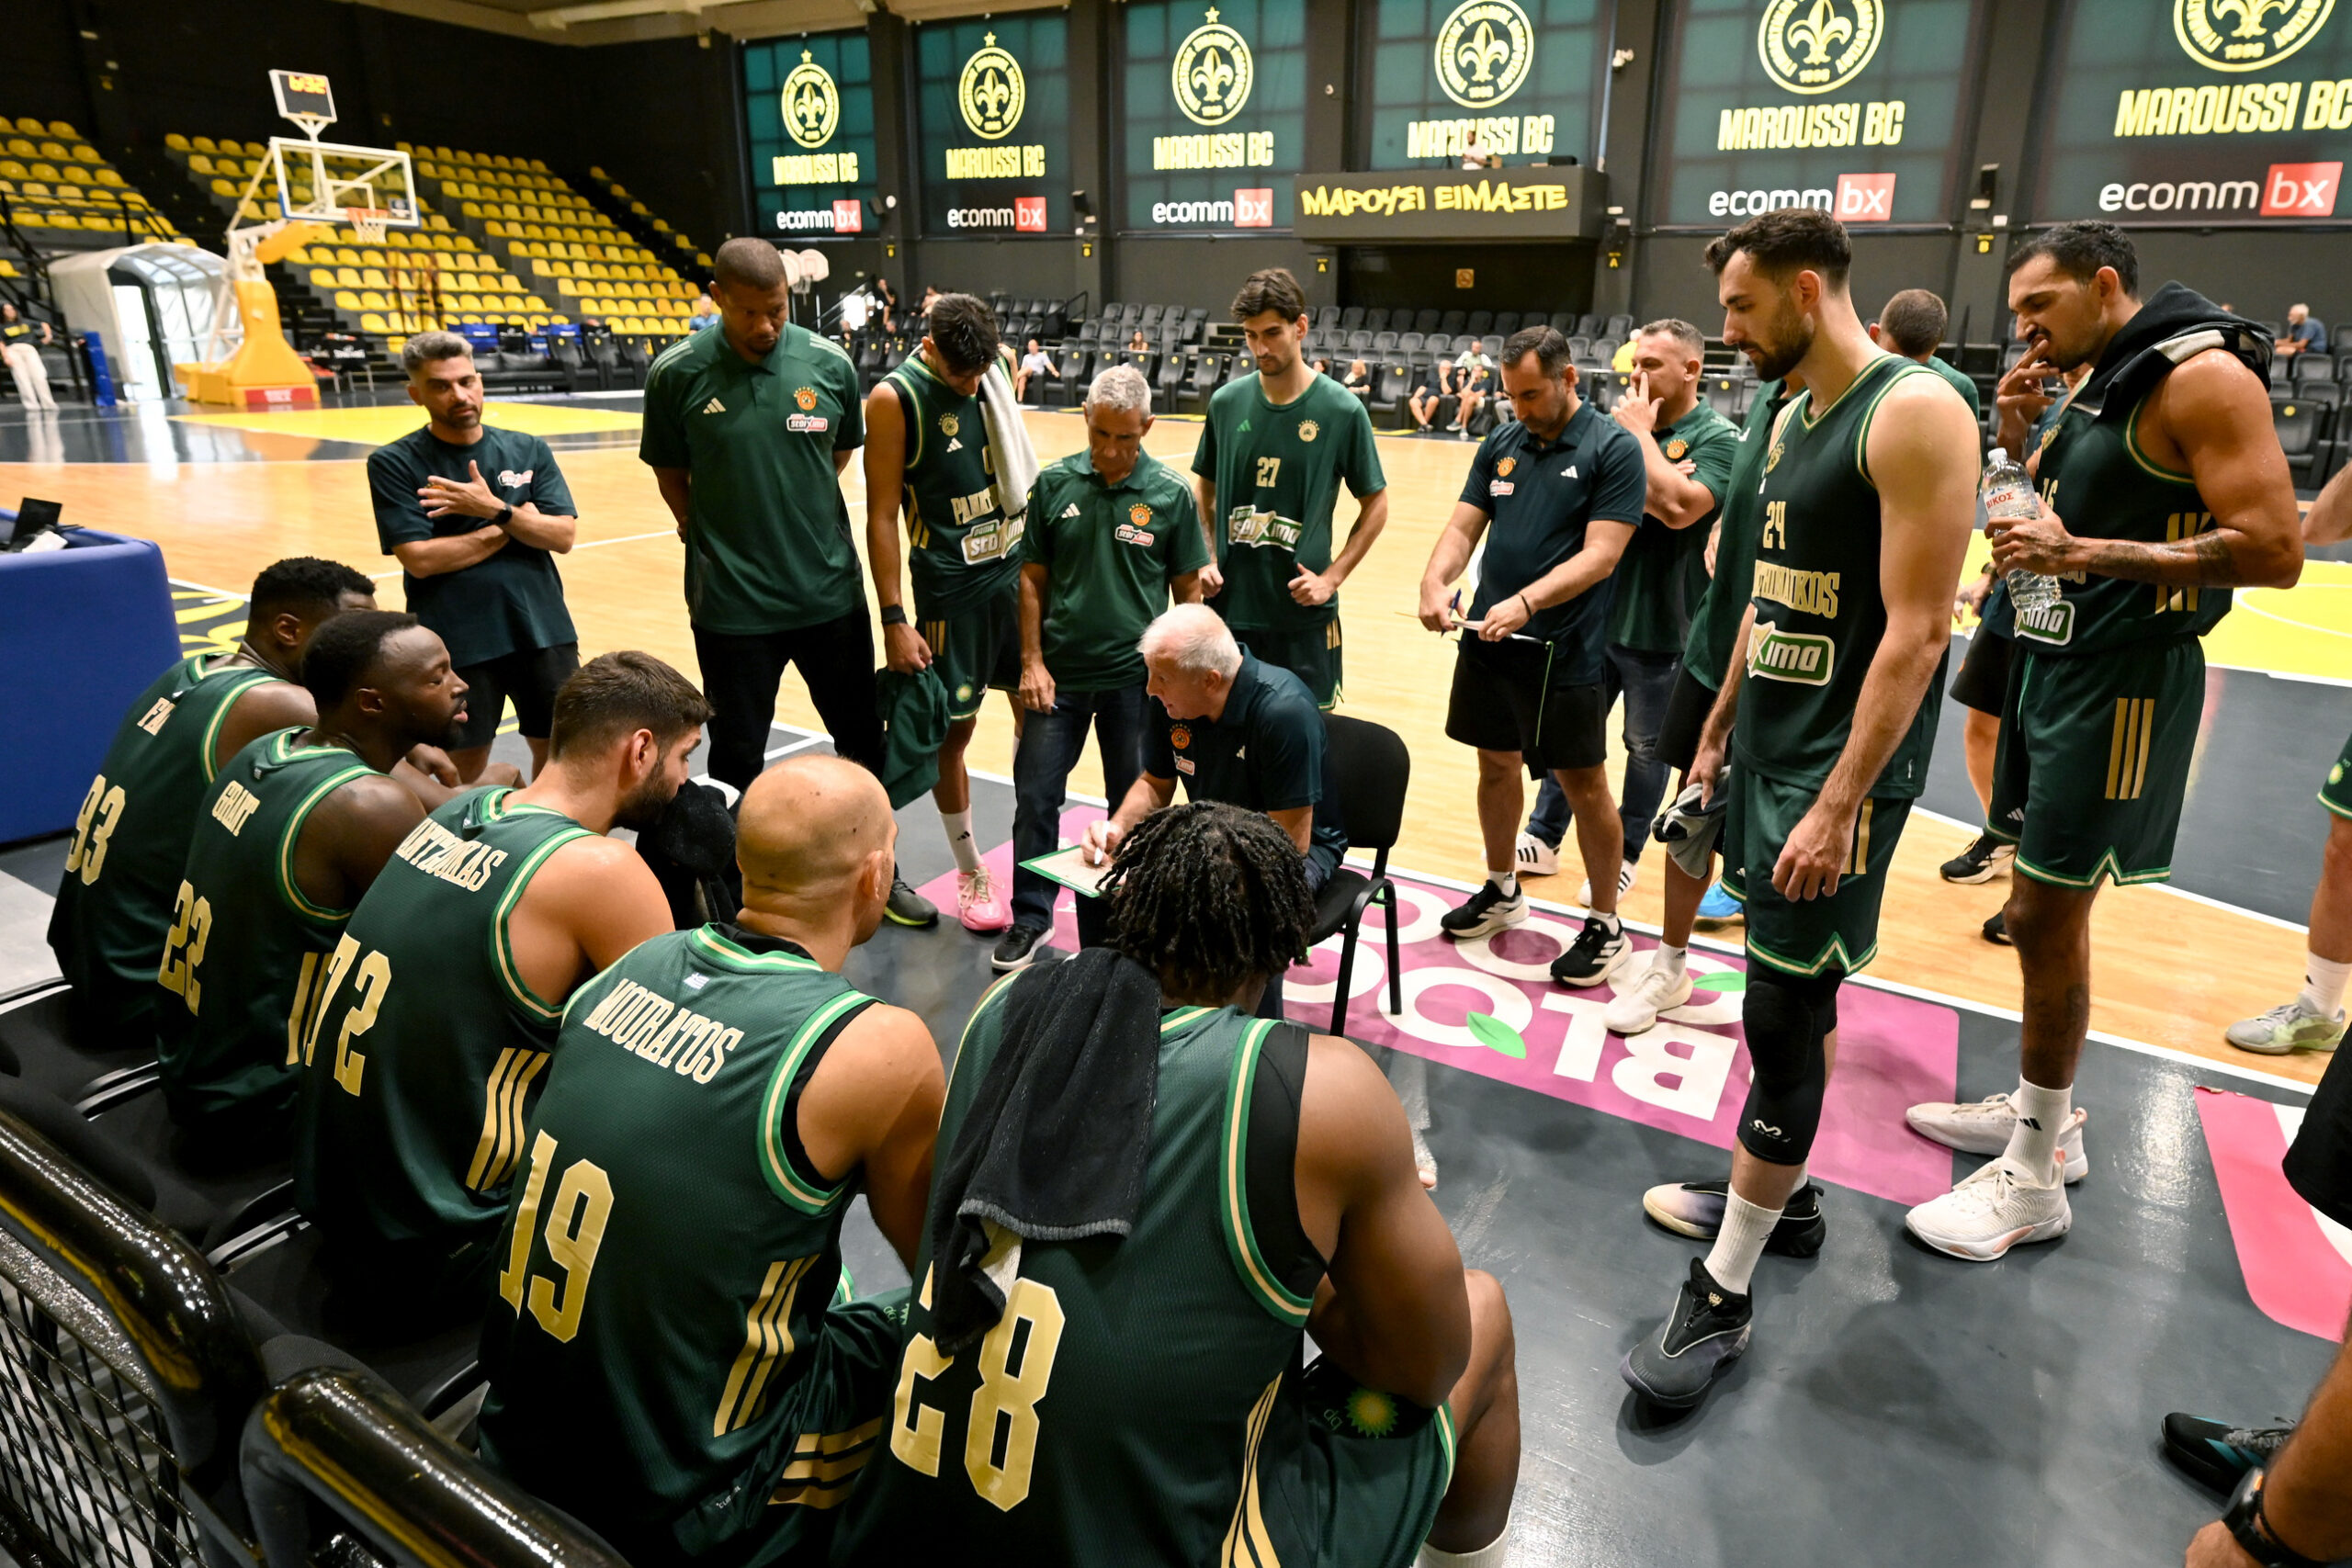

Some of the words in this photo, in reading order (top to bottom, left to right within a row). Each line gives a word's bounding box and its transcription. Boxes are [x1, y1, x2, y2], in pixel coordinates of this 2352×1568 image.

[1521, 115, 1555, 154] BC
[1717, 103, 1860, 151] MAROUSSI
[1862, 101, 1905, 145] BC
[2114, 82, 2301, 137] MAROUSSI
[2302, 79, 2352, 130] BC
[773, 153, 839, 185] MAROUSSI
[838, 152, 859, 183] BC
[946, 145, 1021, 179] MAROUSSI
[1023, 145, 1046, 176] BC
[1153, 132, 1245, 170] MAROUSSI
[1247, 131, 1273, 166] BC
[1256, 457, 1281, 488] 27
[1763, 501, 1787, 550] 24
[65, 774, 126, 886] 93
[212, 780, 261, 837] GRANT
[158, 879, 212, 1016] 22
[305, 931, 391, 1097] 72
[582, 978, 745, 1085] MOURATOS
[500, 1129, 614, 1343] 19
[889, 1260, 1066, 1512] 28
